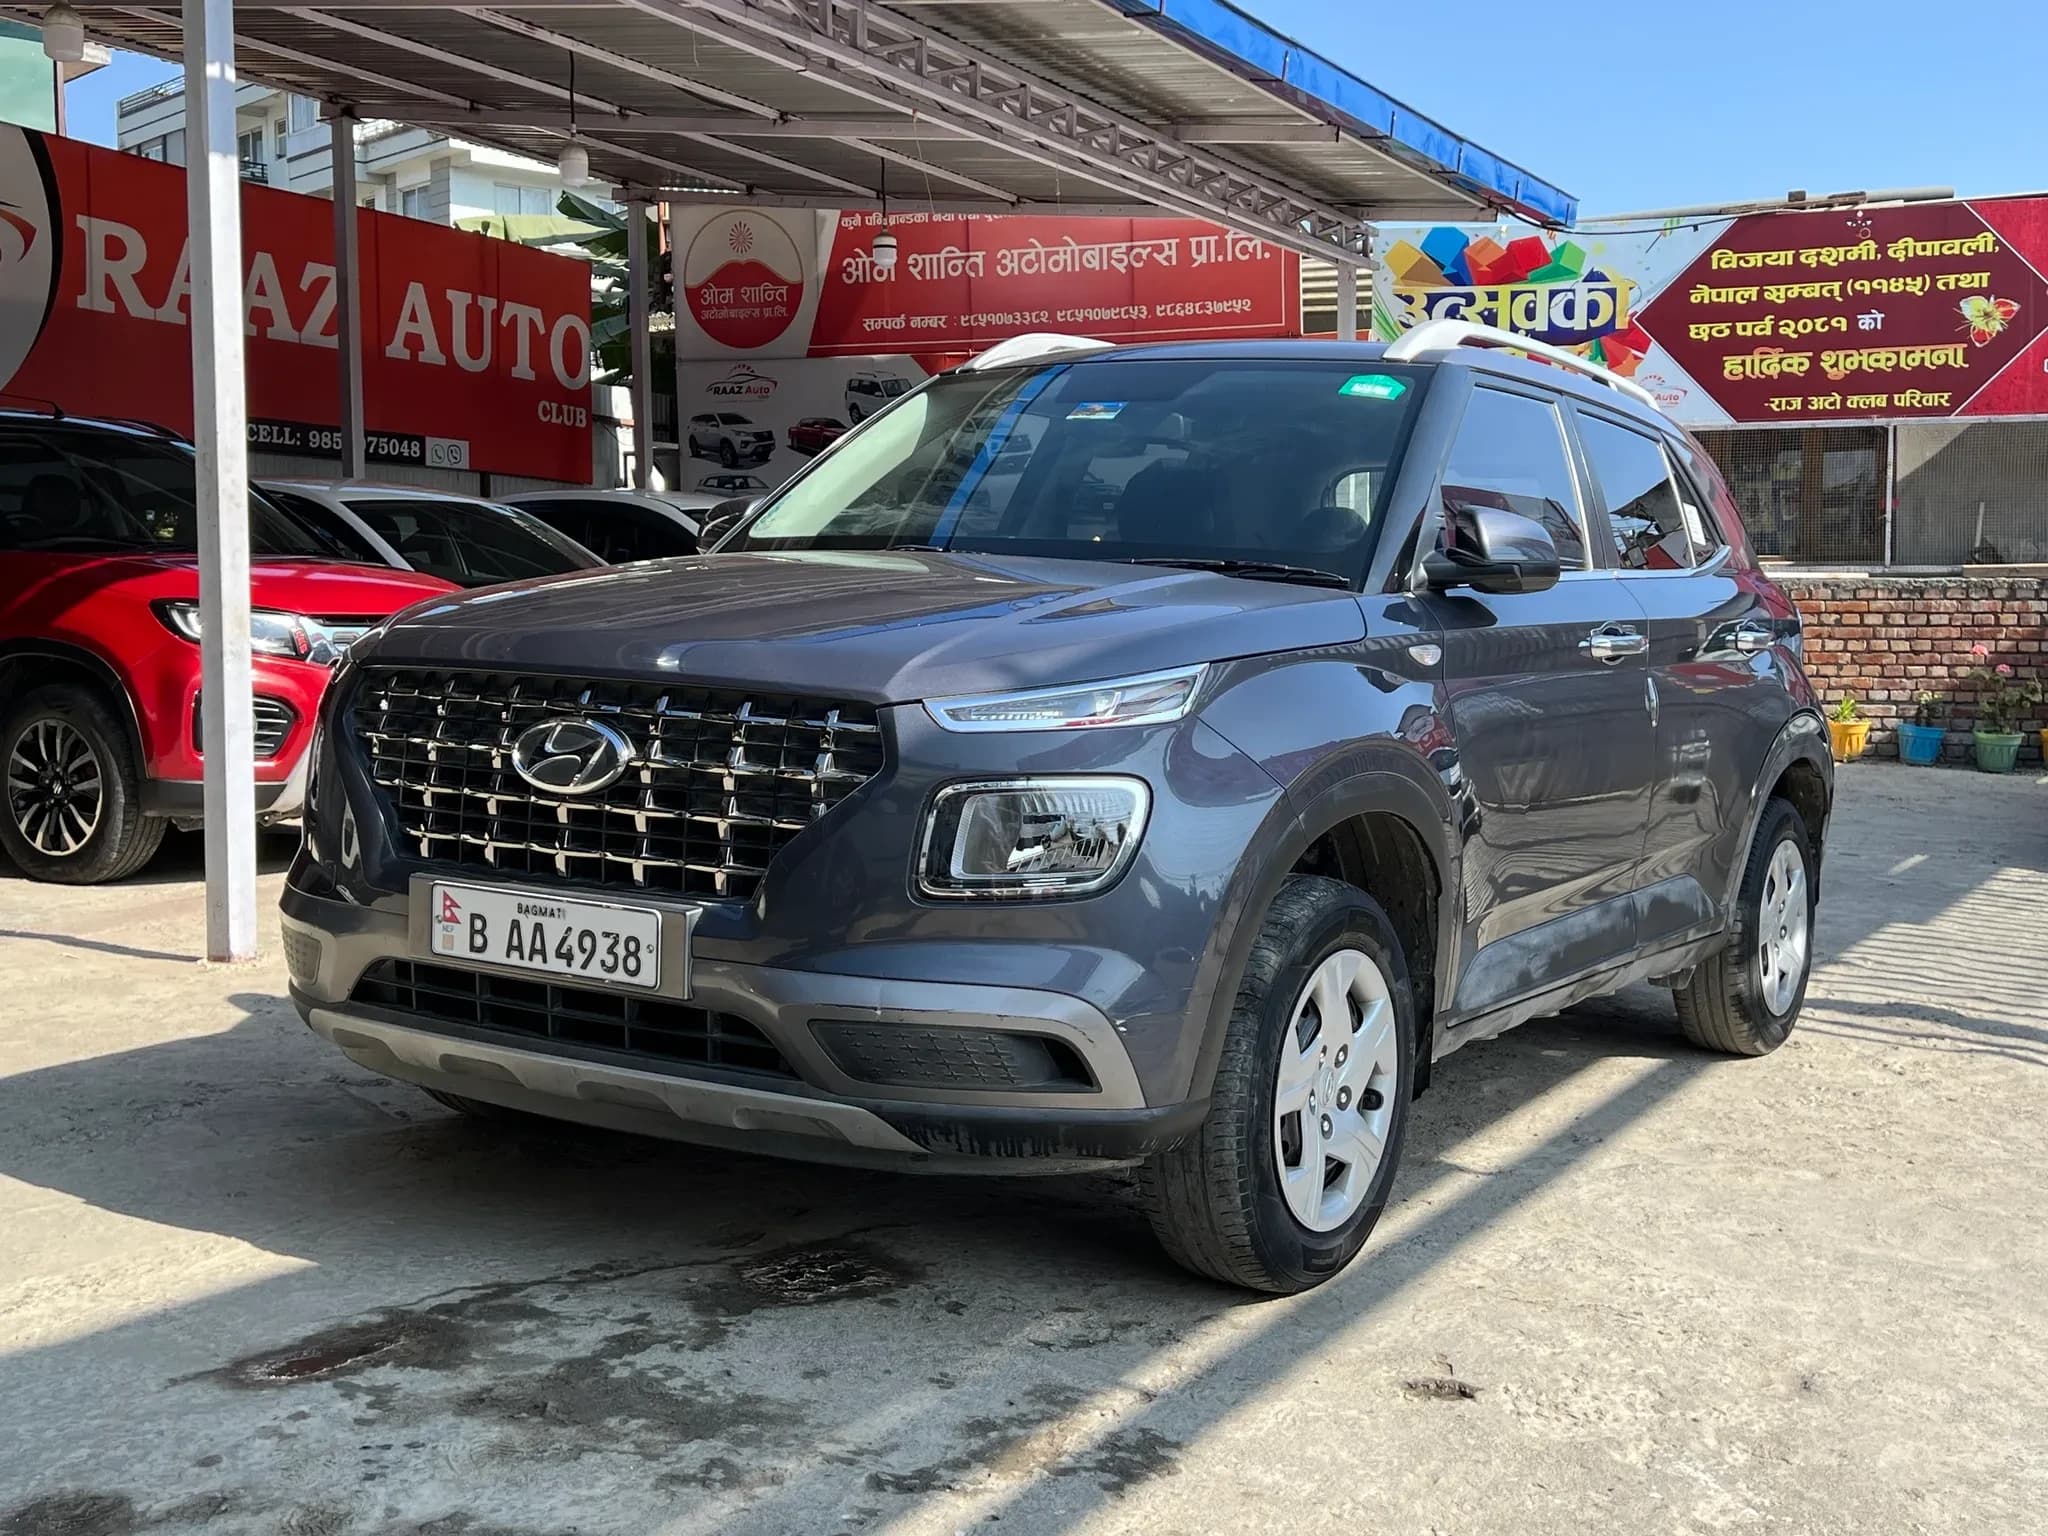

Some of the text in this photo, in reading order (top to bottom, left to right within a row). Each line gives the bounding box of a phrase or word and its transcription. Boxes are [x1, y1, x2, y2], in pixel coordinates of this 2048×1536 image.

[908, 245, 987, 281] शान्ति
[997, 235, 1180, 276] अटोमोबाइल्स
[1711, 232, 2000, 270] विजया दशमी, दीपावली,
[700, 282, 788, 305] ओम शान्ति
[1689, 284, 1760, 304] नेपाल
[1846, 273, 1931, 296] (११४५)
[1936, 271, 1991, 292] तथा
[385, 281, 592, 390] AUTO
[862, 314, 906, 332] सम्पर्क
[909, 315, 948, 329] नम्बर
[1688, 310, 1886, 342] छठ पर्व २०८१ को
[1722, 343, 1970, 381] हार्दिक शुभकामना
[713, 385, 770, 395] RAAZ Auto
[1807, 392, 1842, 410] अटो
[1846, 393, 1888, 409] क्लब
[1893, 389, 1953, 408] परिवार
[537, 400, 588, 428] CLUB
[247, 423, 301, 446] CELL:
